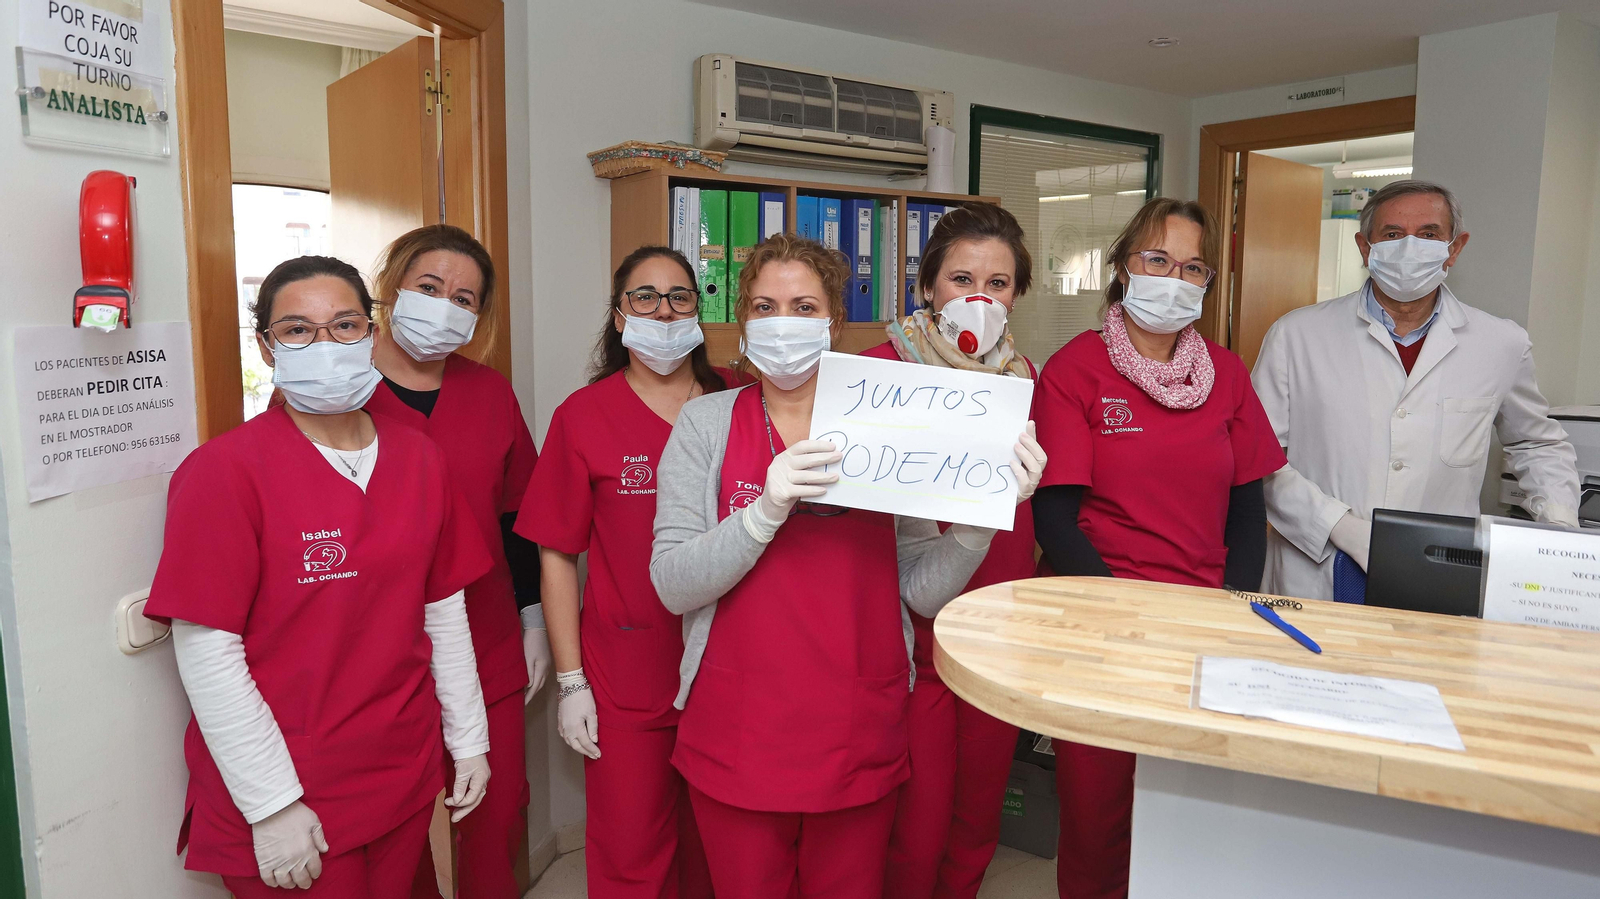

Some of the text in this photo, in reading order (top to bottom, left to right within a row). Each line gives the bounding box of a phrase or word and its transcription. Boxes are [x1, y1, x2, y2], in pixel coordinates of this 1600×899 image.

[49, 2, 138, 44] POR FAVOR
[64, 34, 132, 67] COJA SU
[73, 62, 131, 91] TURNO
[1296, 87, 1336, 100] LABORATORIO
[47, 89, 146, 125] ANALISTA
[35, 349, 166, 371] LOS PACIENTES DE ASISA
[37, 386, 84, 401] DEBERAN
[87, 377, 129, 395] PEDIR
[132, 375, 163, 390] CITA
[843, 379, 991, 417] JUNTOS
[39, 398, 174, 424] PARA EL DIA DE LOS ANÁLISIS
[41, 422, 133, 445] EN EL MOSTRADOR
[42, 432, 181, 465] O POR TELEFONO: 956 631568
[623, 454, 648, 463] Paula
[301, 528, 342, 541] Isabel
[1538, 548, 1596, 561] RECOGIDA
[297, 570, 358, 584] LAB. OCHANDO
[1524, 583, 1540, 591] DNI
[1540, 617, 1551, 625] DE
[1552, 619, 1580, 629] AMBAS
[1002, 800, 1021, 808] ADO
